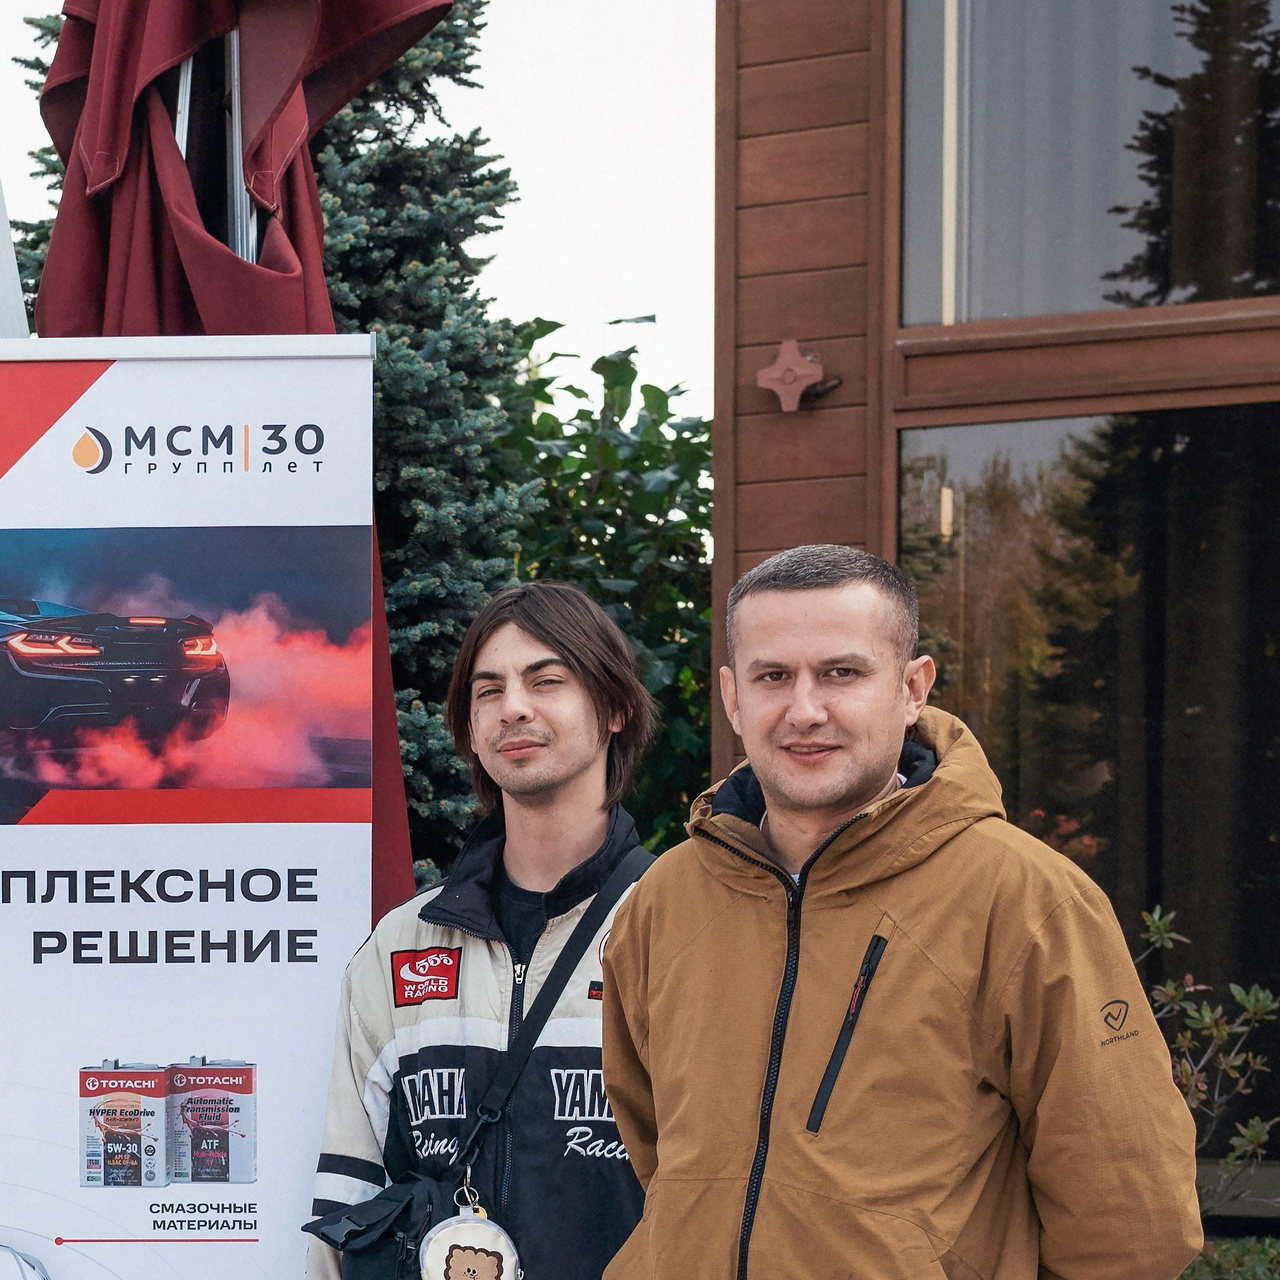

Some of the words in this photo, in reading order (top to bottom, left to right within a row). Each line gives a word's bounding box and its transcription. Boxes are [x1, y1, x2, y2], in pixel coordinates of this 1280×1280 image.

[261, 423, 325, 456] 30
[32, 929, 319, 965] РЕШЕНИЕ
[415, 953, 454, 974] 555
[404, 980, 449, 992] WORLD
[1100, 1029, 1140, 1047] NORTHLAND
[100, 1079, 156, 1089] TOTACHI
[188, 1076, 244, 1085] TOTACHI
[186, 1097, 234, 1105] Automatic
[550, 1068, 616, 1122] YAM
[89, 1108, 118, 1117] HYPER
[119, 1108, 156, 1117] EcoDrive
[198, 1113, 222, 1121] Fluid
[107, 1142, 138, 1154] 5W-30
[200, 1139, 220, 1150] ATF
[149, 1202, 258, 1214] СМАЗОЧНЫЕ
[152, 1219, 258, 1231] МАТЕРИАЛЫ
